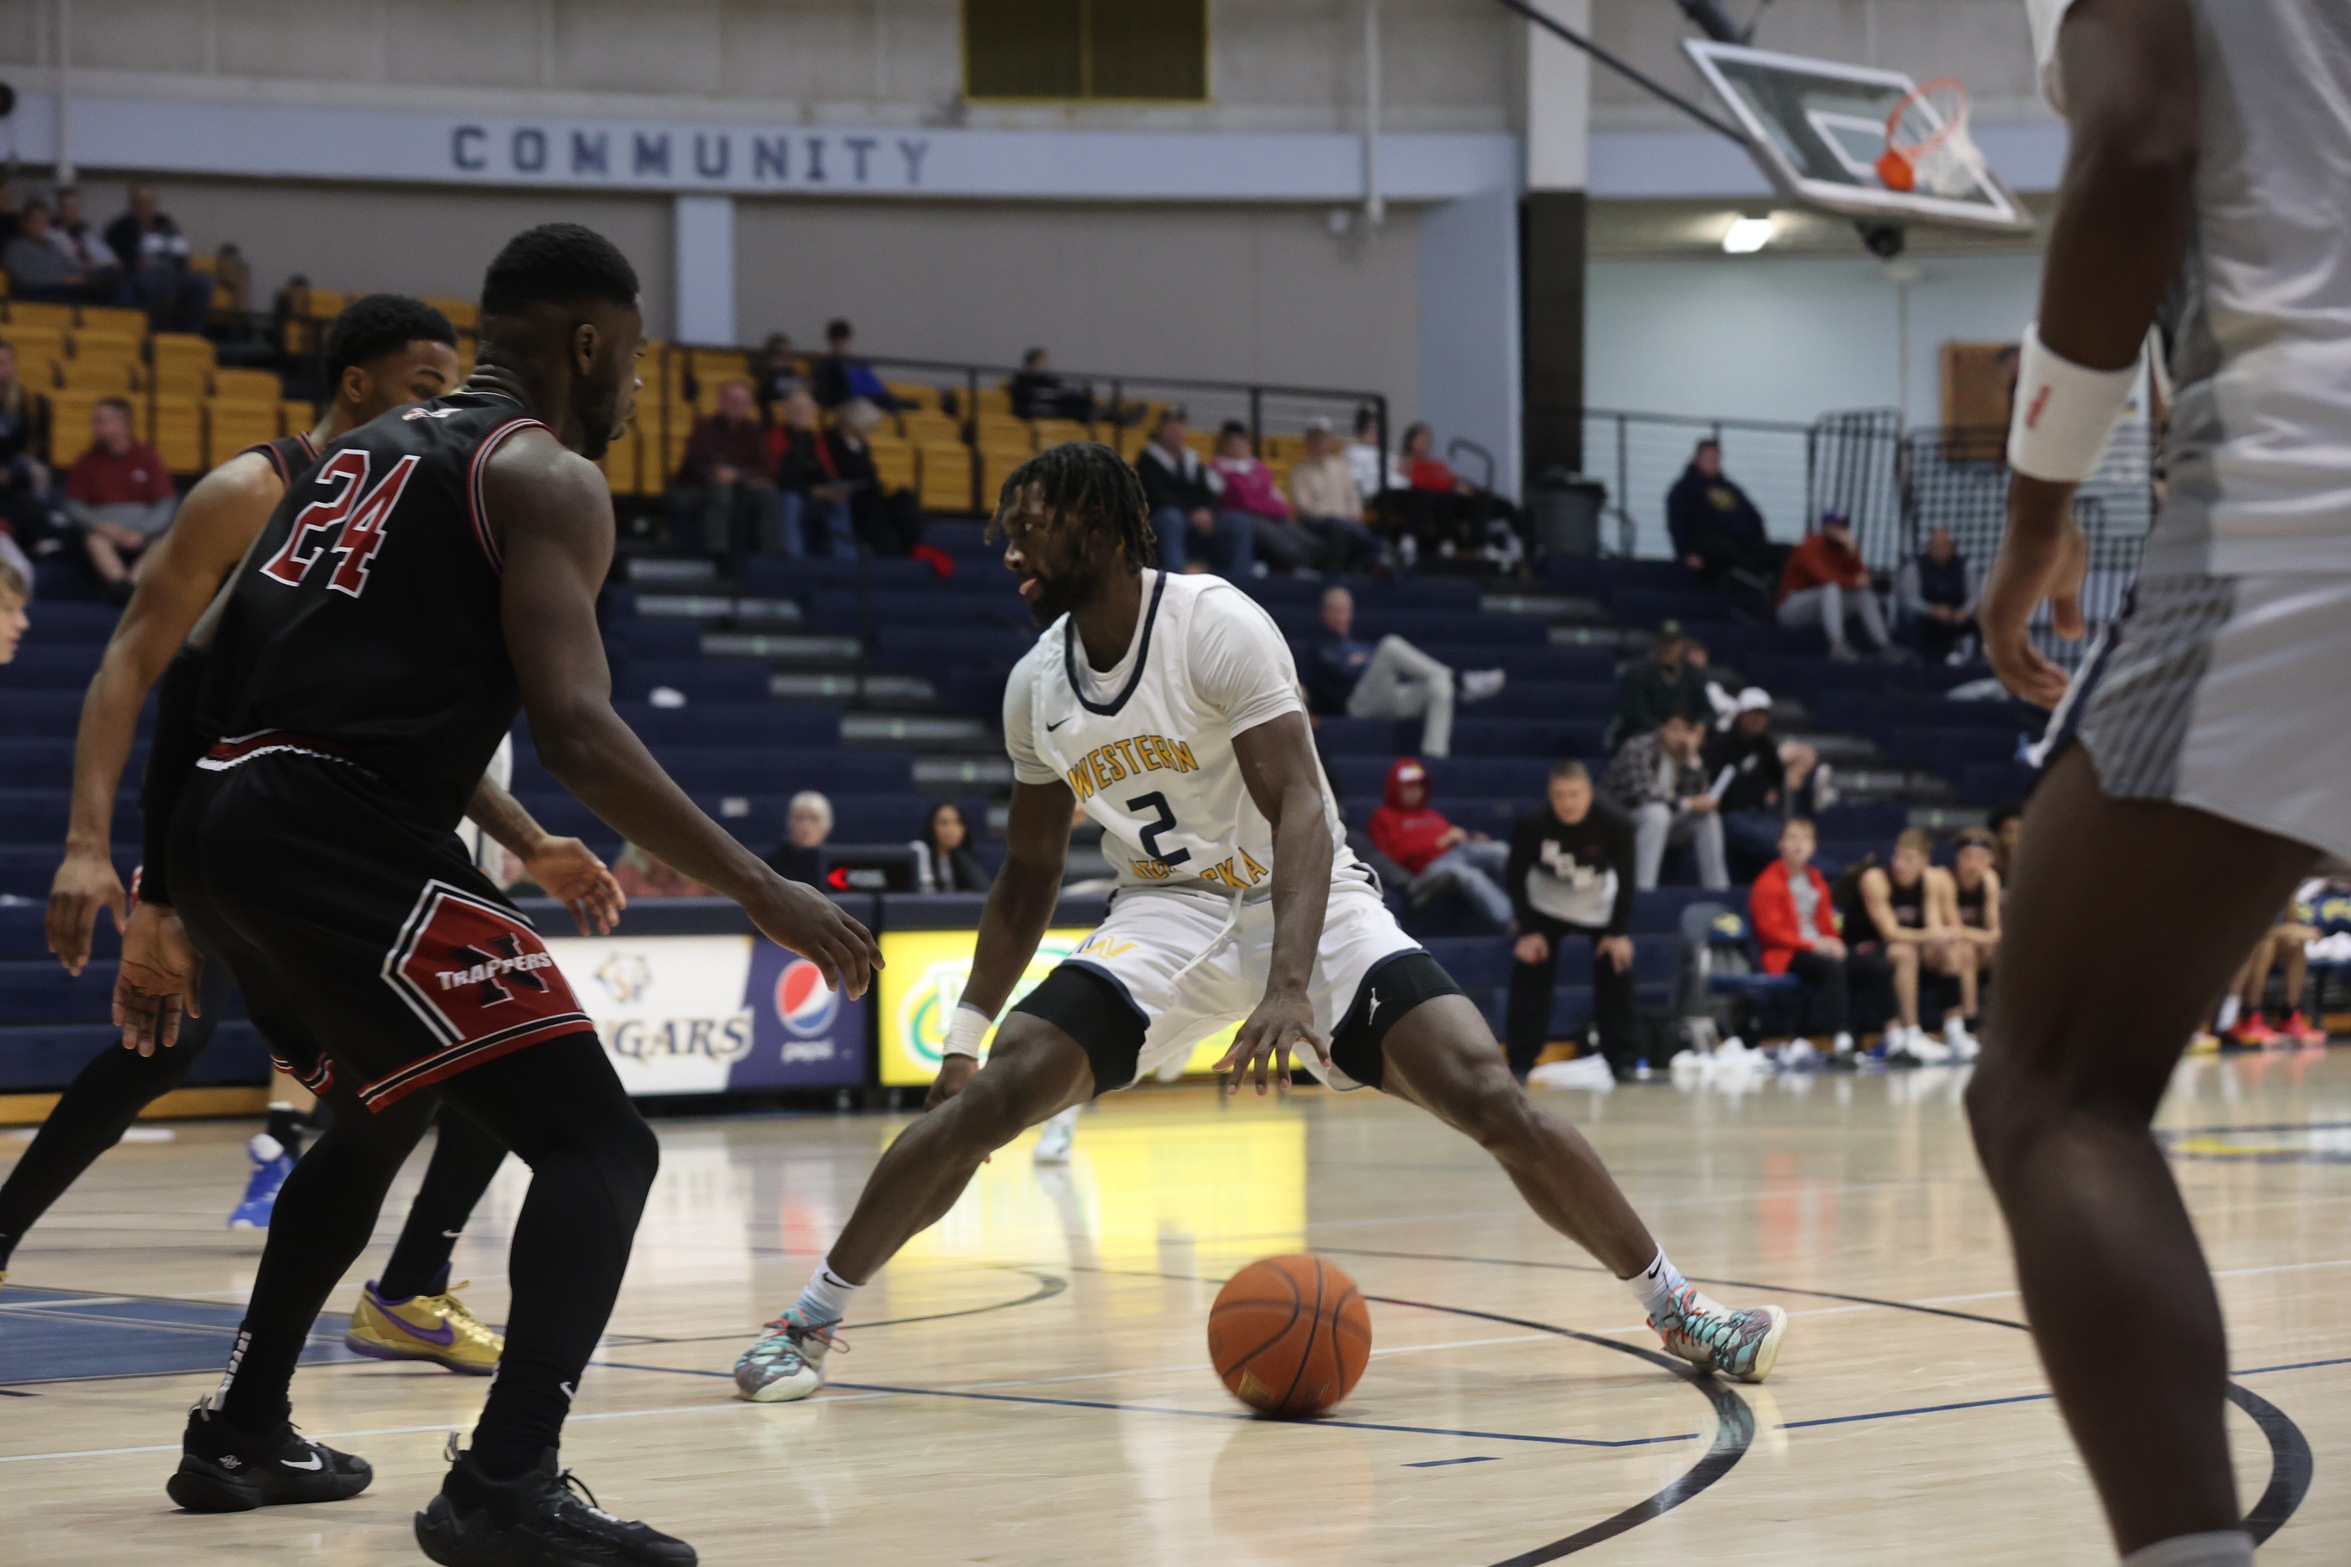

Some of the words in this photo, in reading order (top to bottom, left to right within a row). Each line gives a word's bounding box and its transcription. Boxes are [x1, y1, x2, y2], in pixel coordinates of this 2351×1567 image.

[451, 126, 929, 184] COMMUNITY
[259, 449, 421, 599] 24
[1067, 735, 1199, 803] WESTERN
[1126, 791, 1192, 867] 2
[435, 951, 553, 991] TRAPPERS
